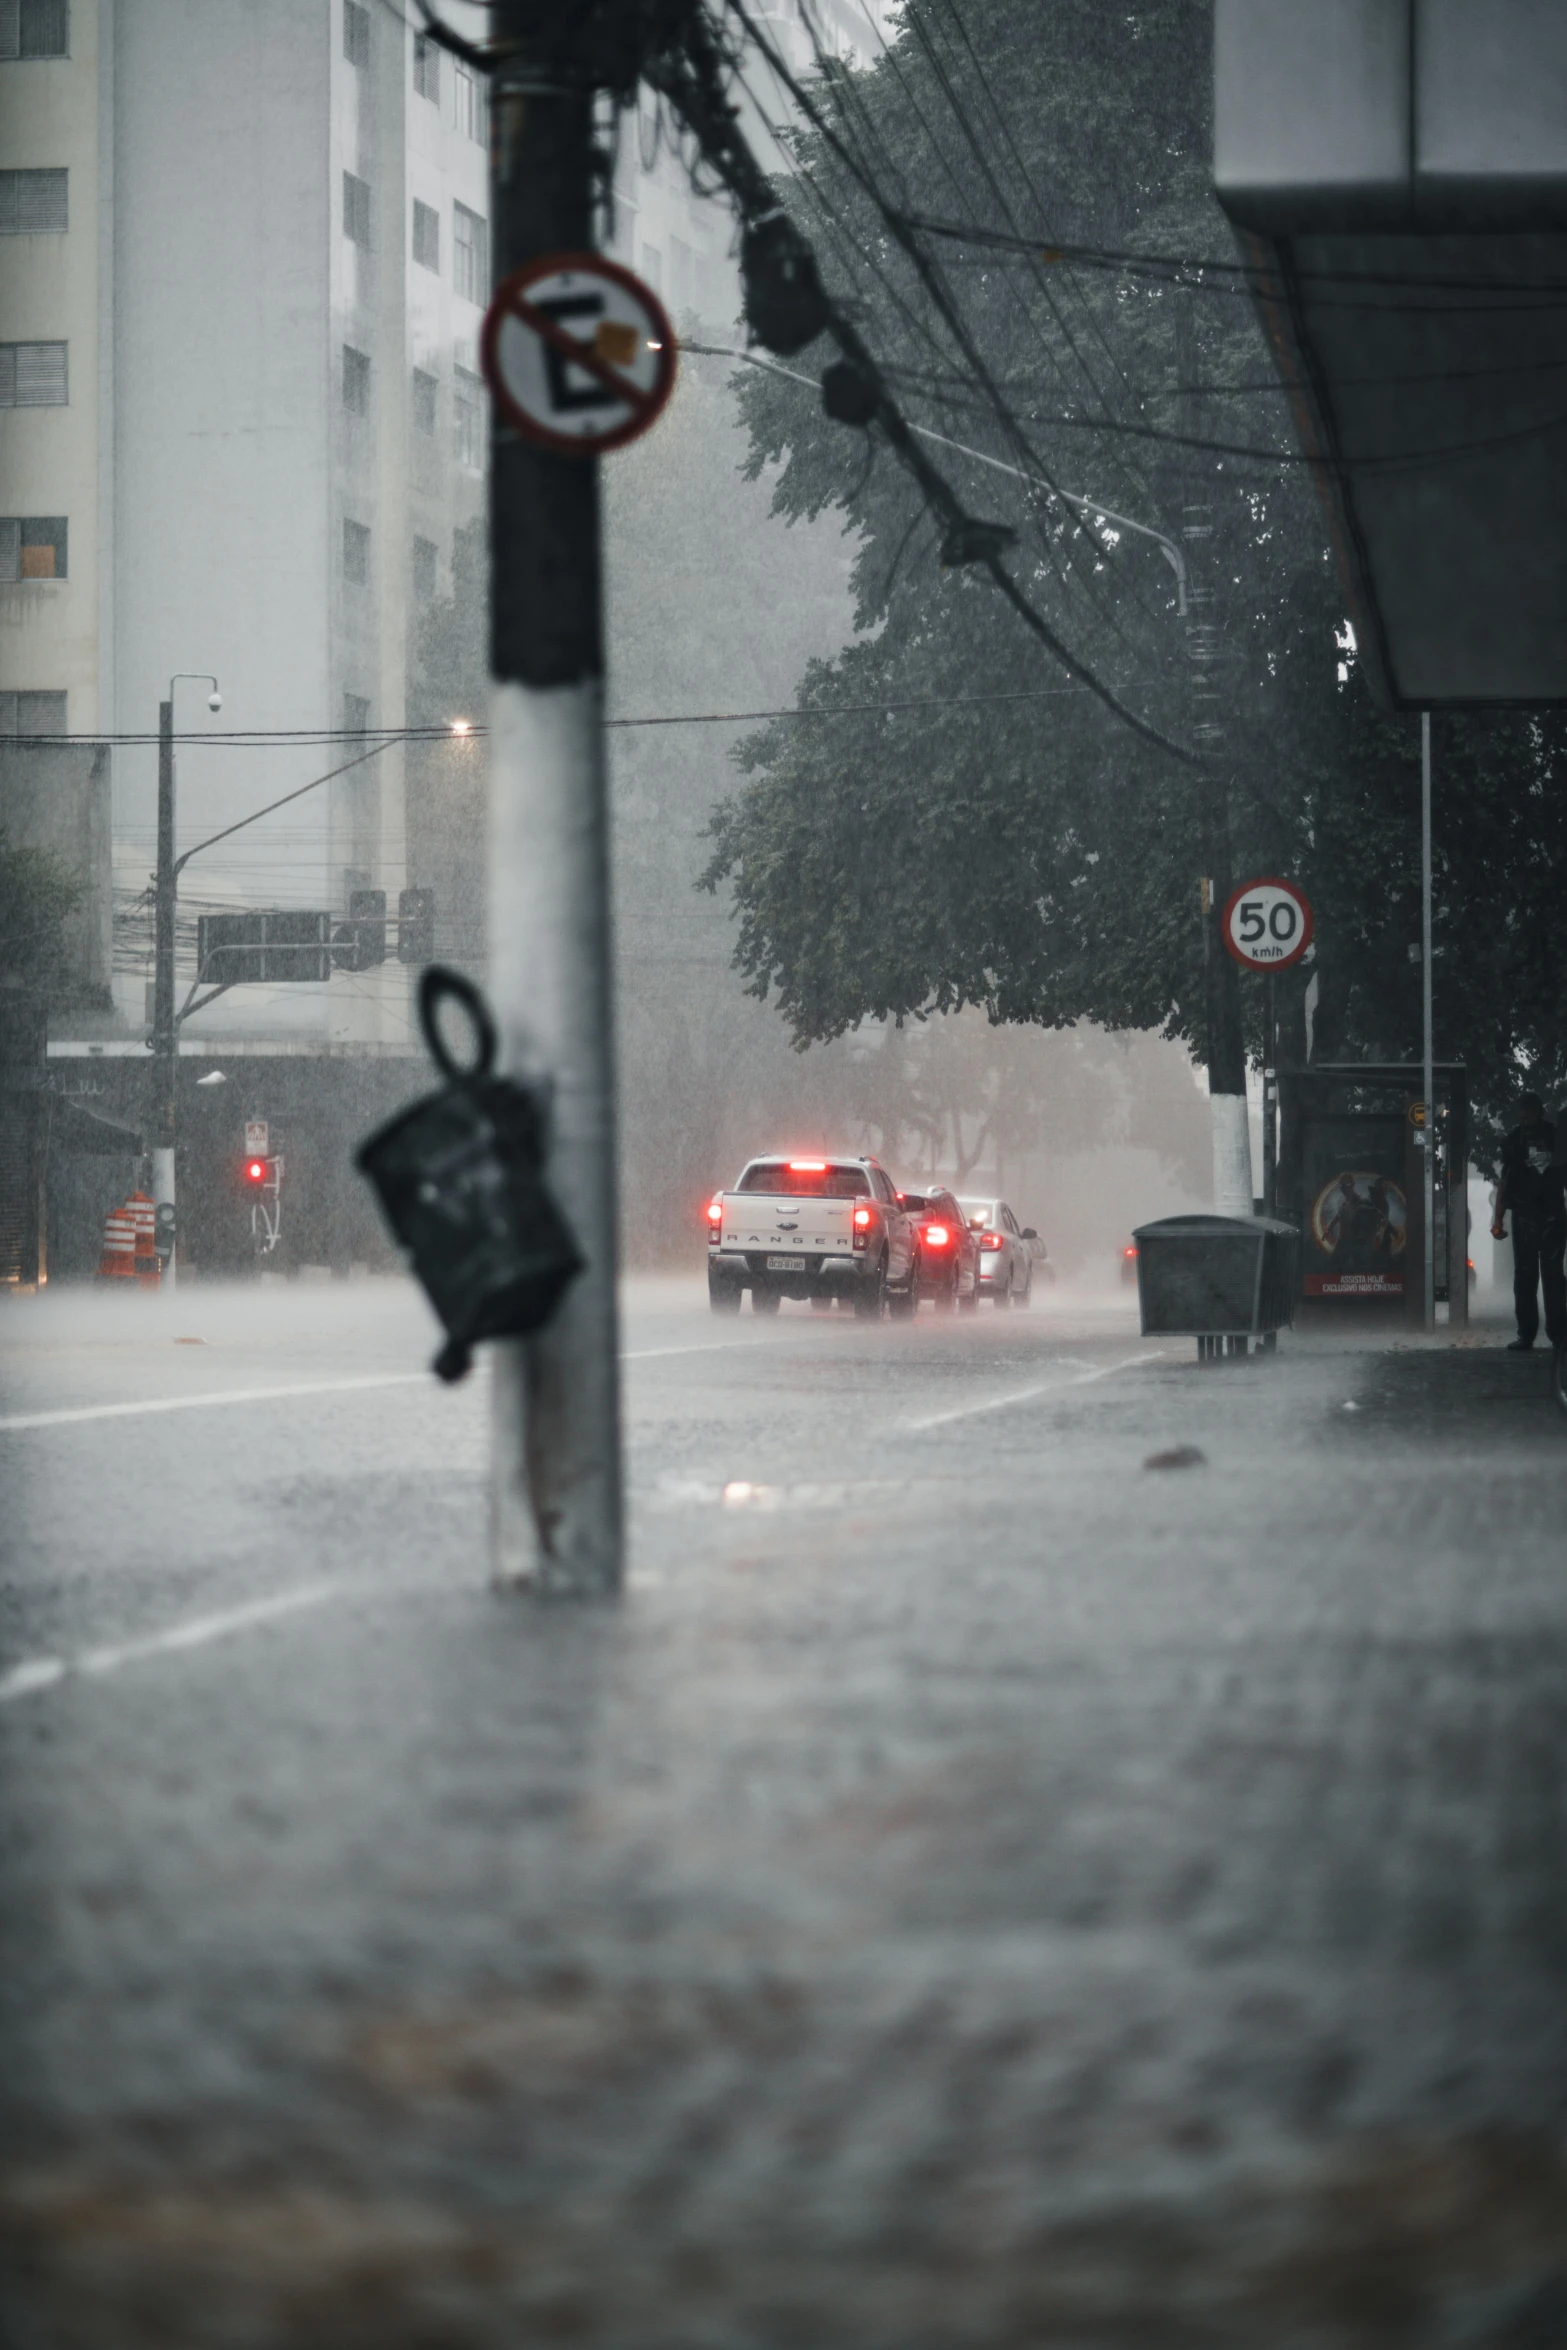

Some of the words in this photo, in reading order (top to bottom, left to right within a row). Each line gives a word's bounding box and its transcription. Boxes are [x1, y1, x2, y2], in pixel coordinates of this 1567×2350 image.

[1239, 902, 1296, 942] 50
[1252, 946, 1283, 958] km/h
[727, 1234, 848, 1245] RANGER
[1340, 1275, 1366, 1283] ASSISTA
[1367, 1275, 1384, 1283] HOJE
[1322, 1283, 1357, 1292] EXCLUSIVO
[1358, 1283, 1373, 1292] NOS
[1373, 1283, 1402, 1292] CINEMAS
